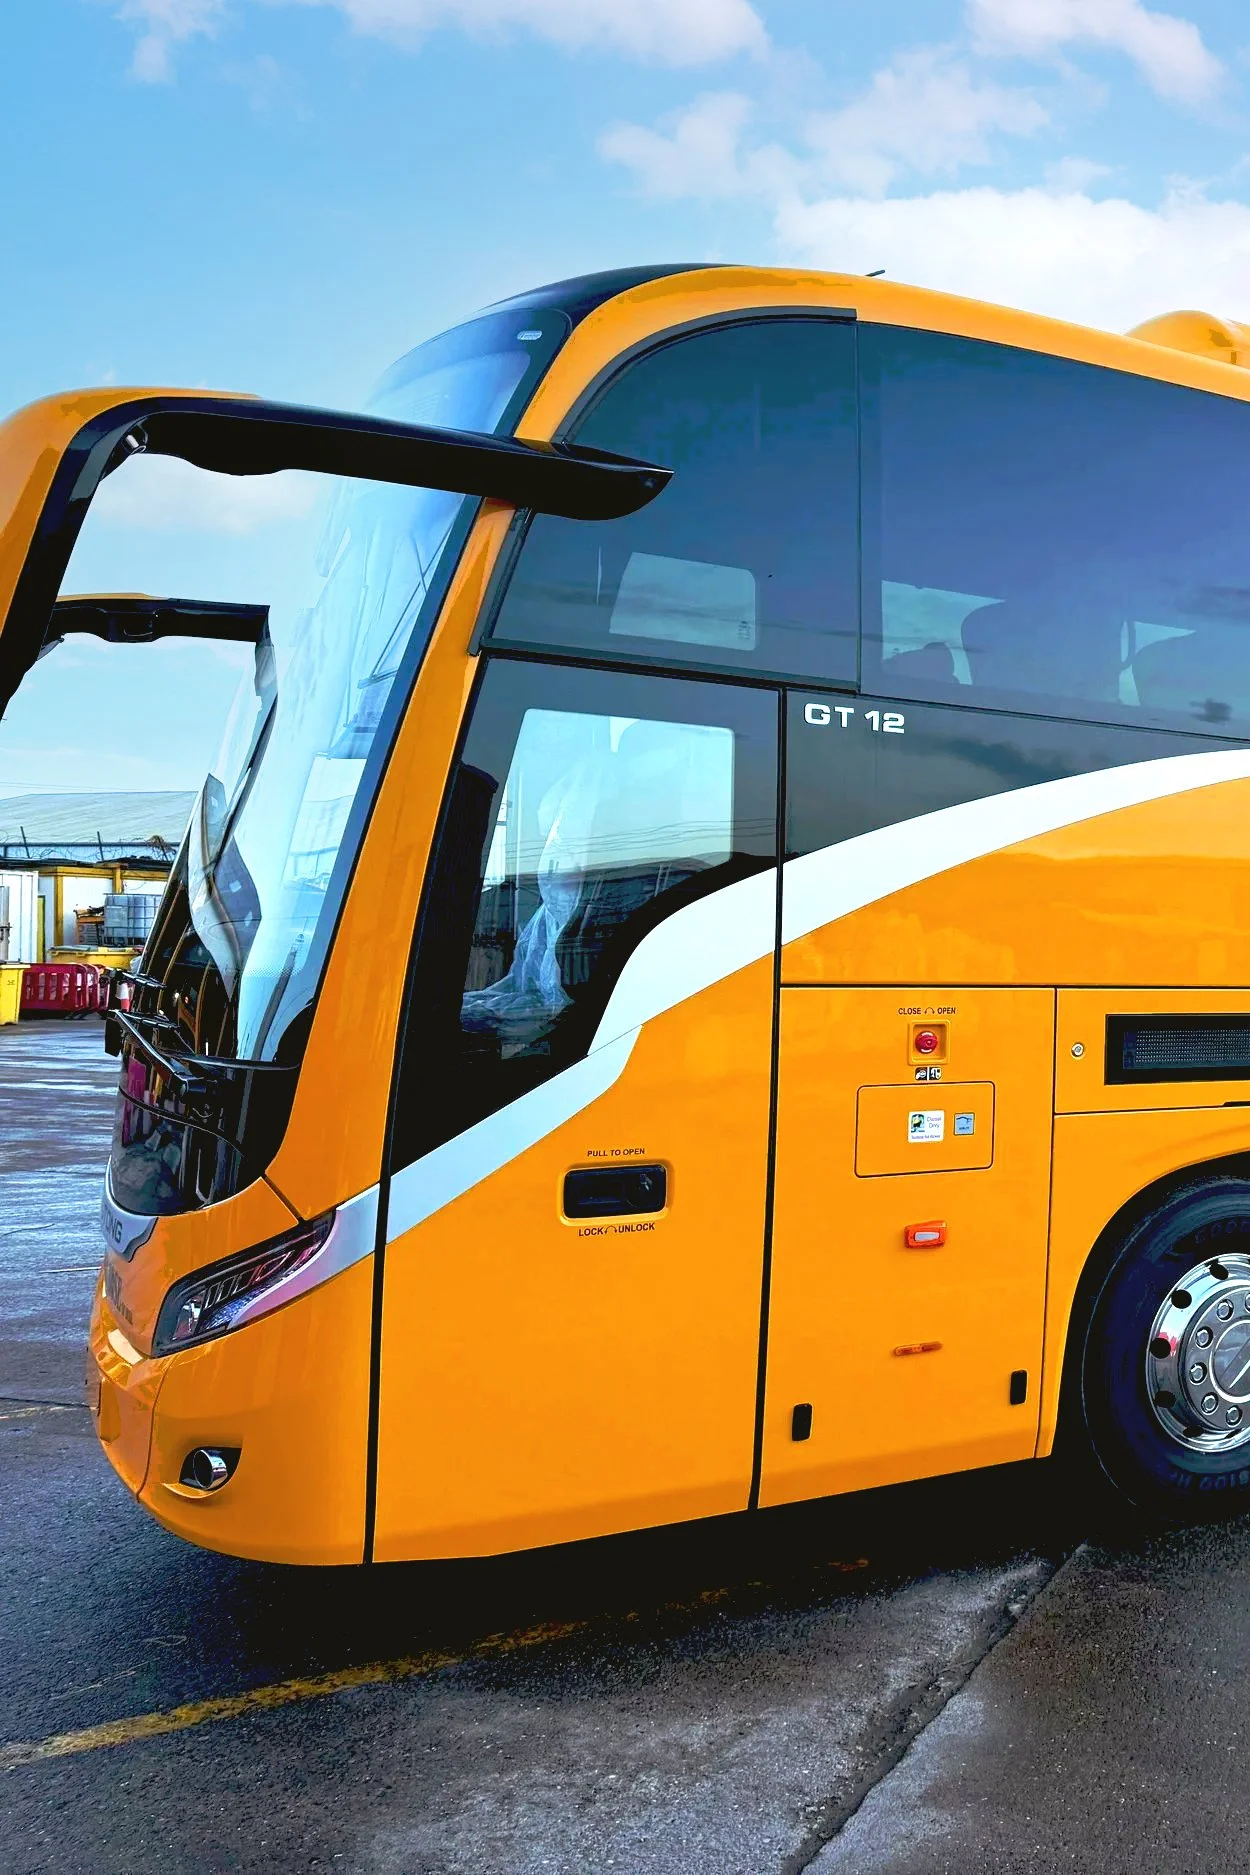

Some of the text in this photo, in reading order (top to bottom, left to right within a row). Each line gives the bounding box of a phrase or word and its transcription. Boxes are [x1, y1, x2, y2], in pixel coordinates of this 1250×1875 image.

[804, 702, 905, 734] GT 12
[898, 1007, 922, 1015] CLOSE
[578, 1222, 655, 1237] LOCK UNLOCK
